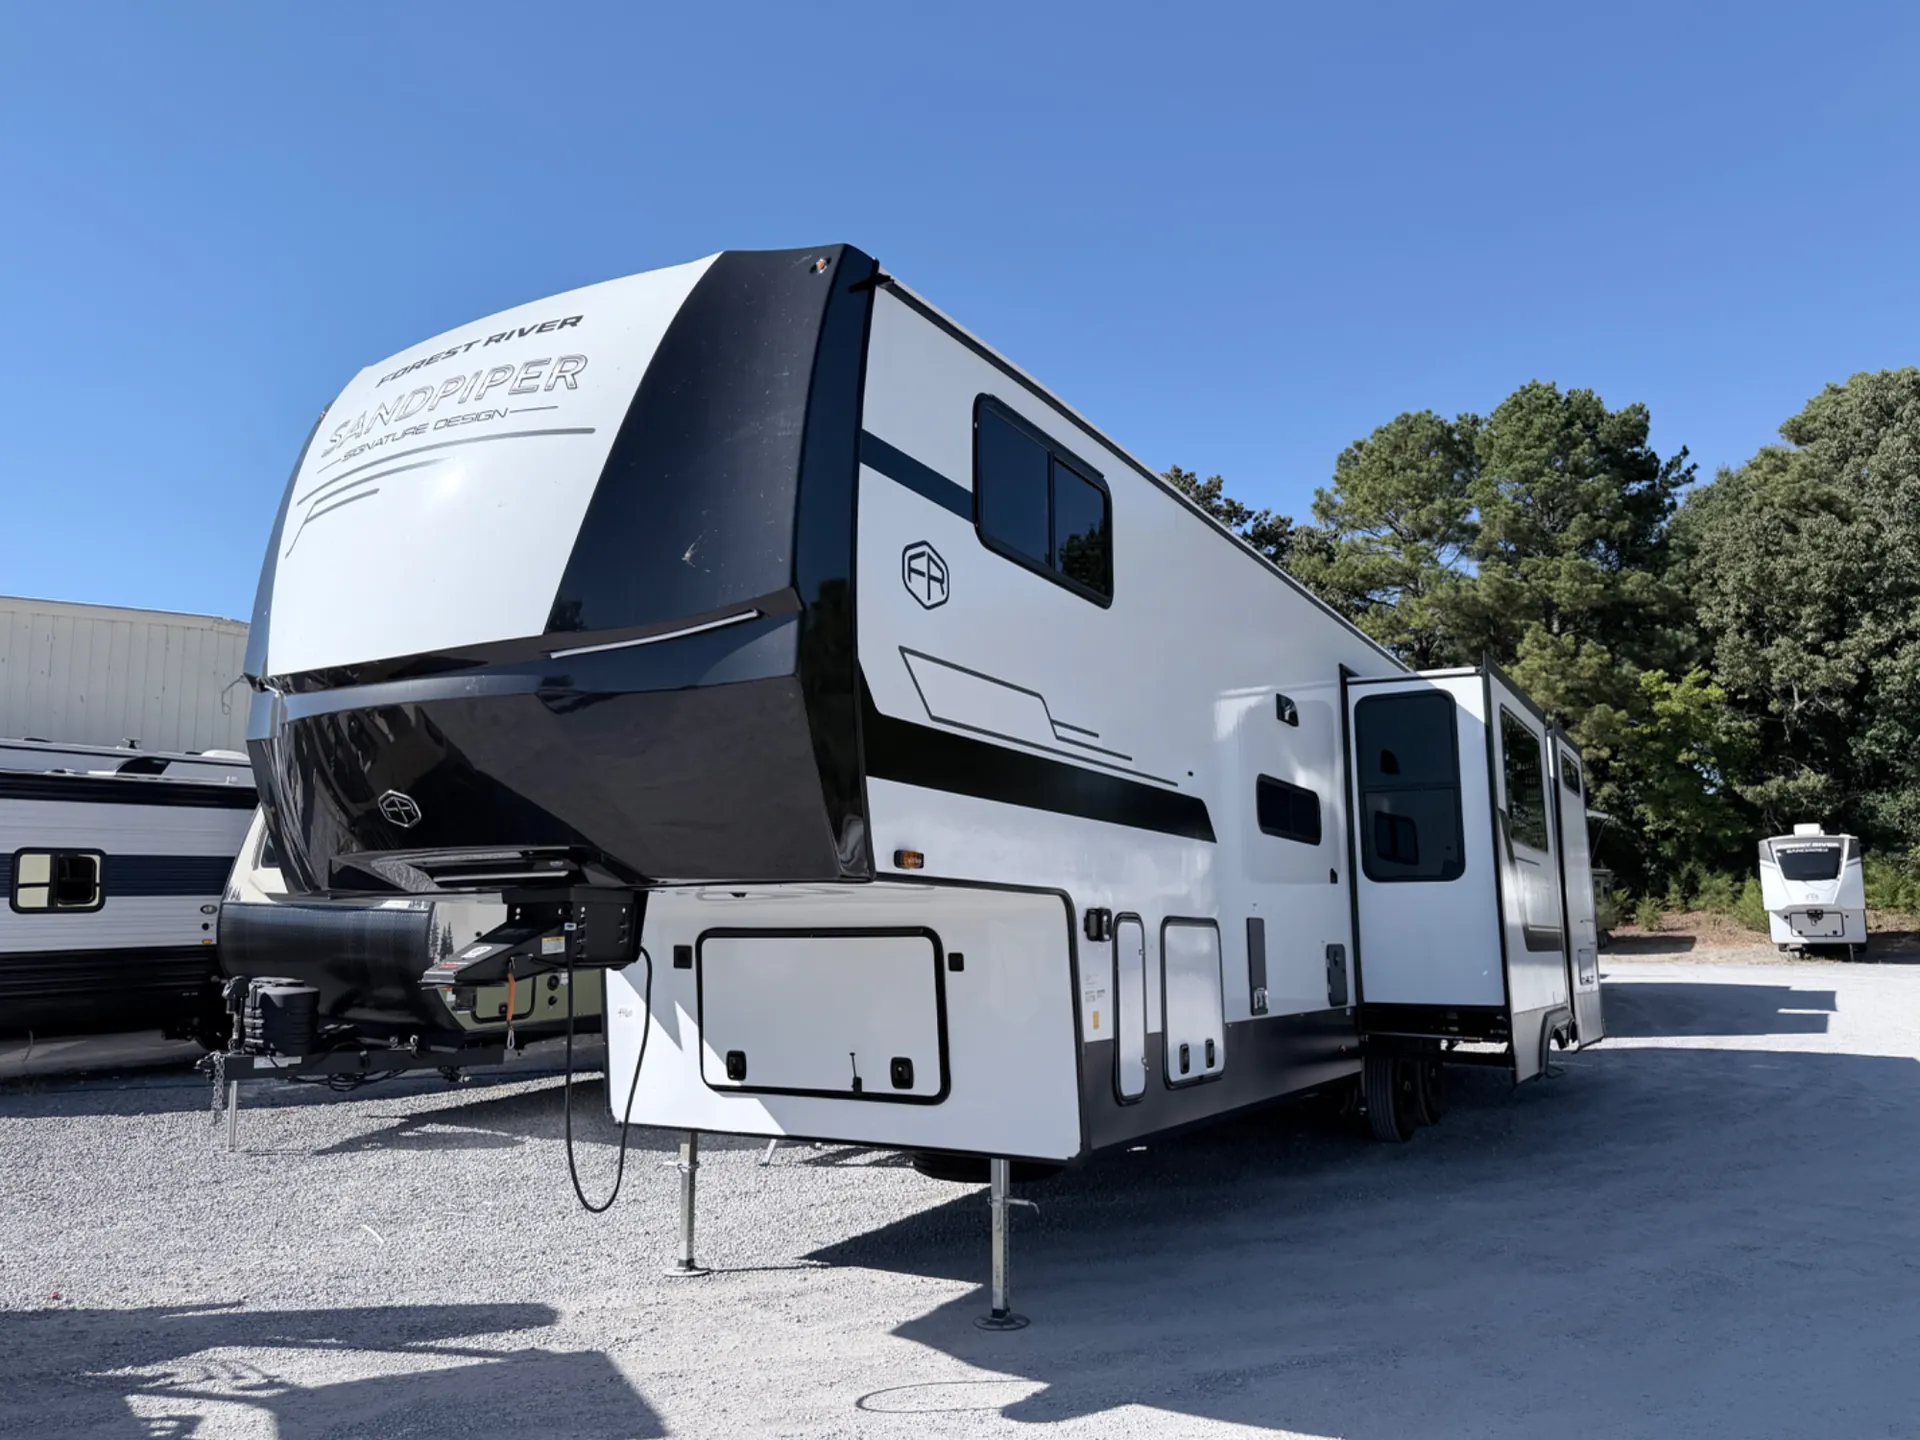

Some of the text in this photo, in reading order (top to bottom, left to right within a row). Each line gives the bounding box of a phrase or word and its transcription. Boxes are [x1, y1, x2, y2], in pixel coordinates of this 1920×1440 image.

[375, 315, 584, 388] FOREST RIVER
[320, 353, 588, 459] SANDPIPER
[341, 407, 509, 462] SIGNATURE DESIGN
